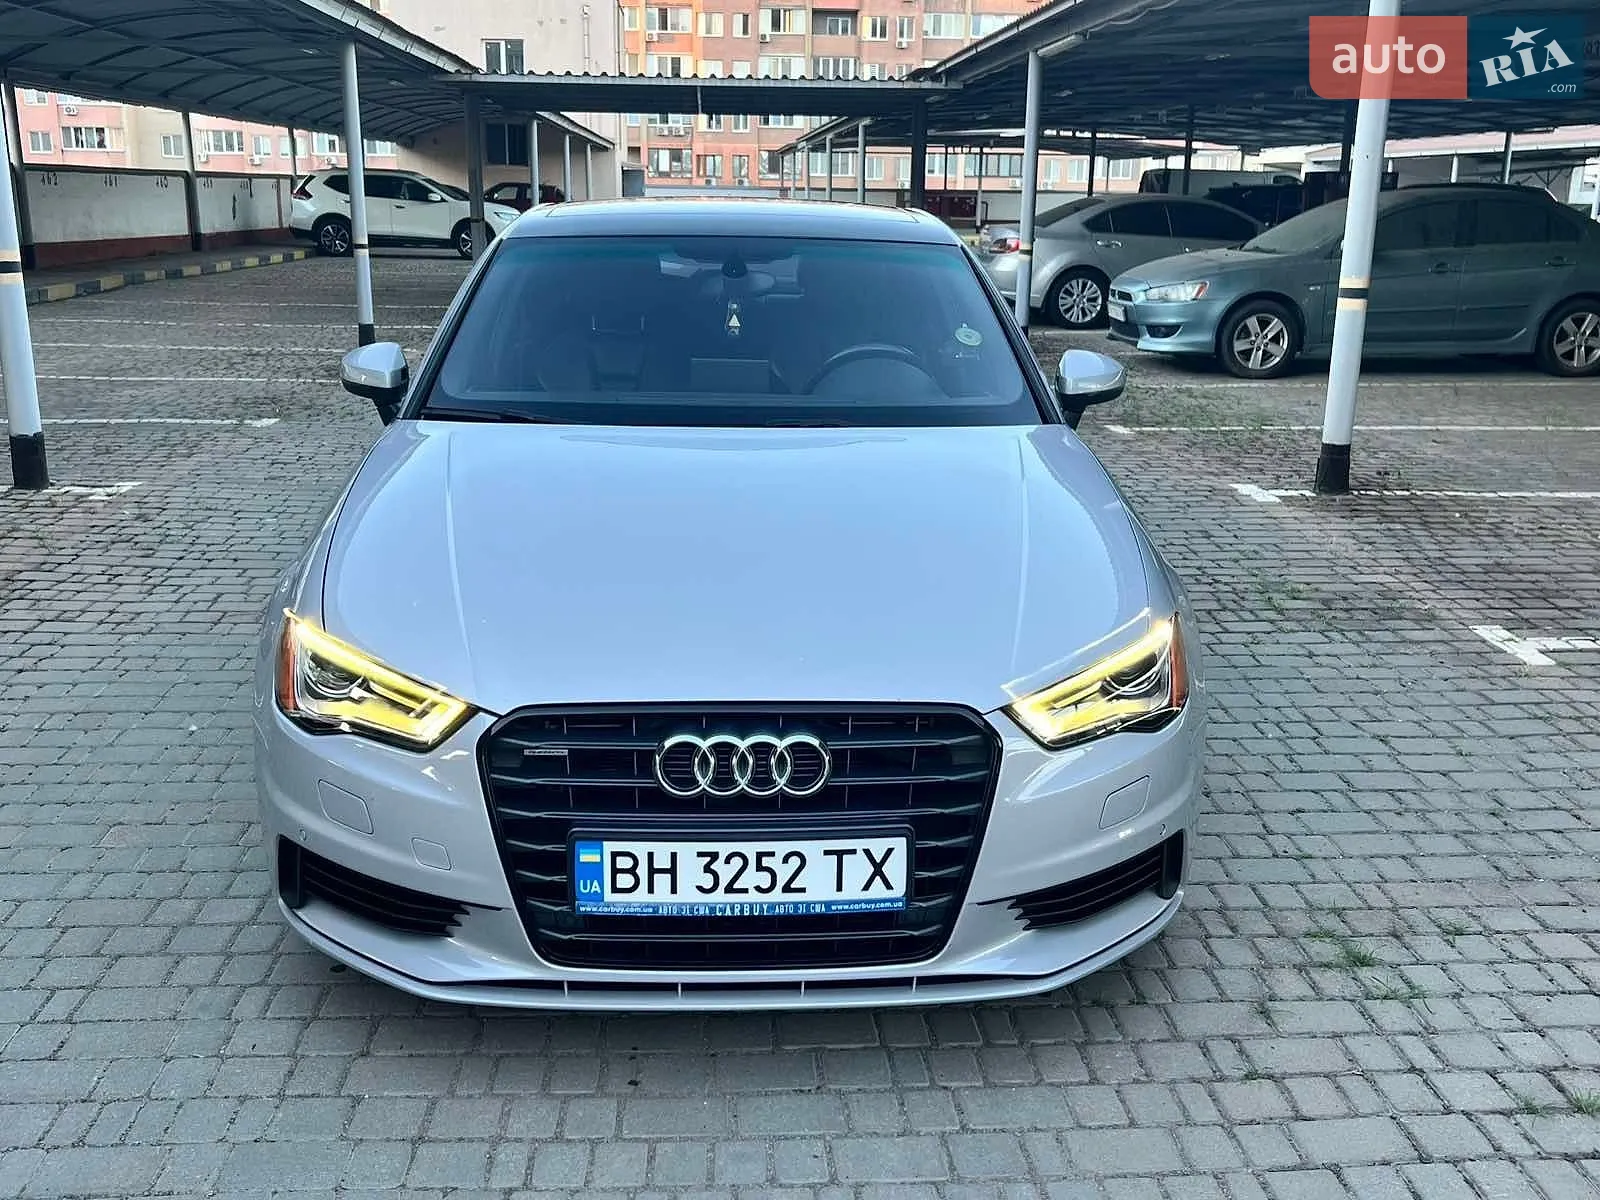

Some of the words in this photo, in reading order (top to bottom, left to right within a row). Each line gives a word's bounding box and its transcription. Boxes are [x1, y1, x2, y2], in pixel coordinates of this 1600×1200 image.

[609, 851, 678, 894] BH
[696, 850, 807, 894] 3252
[823, 848, 896, 892] TX
[580, 880, 601, 893] UA
[579, 905, 653, 914] www.carbuy.com.ua
[716, 904, 768, 916] CARBUY
[831, 901, 903, 911] www.carbuy.com.ua
